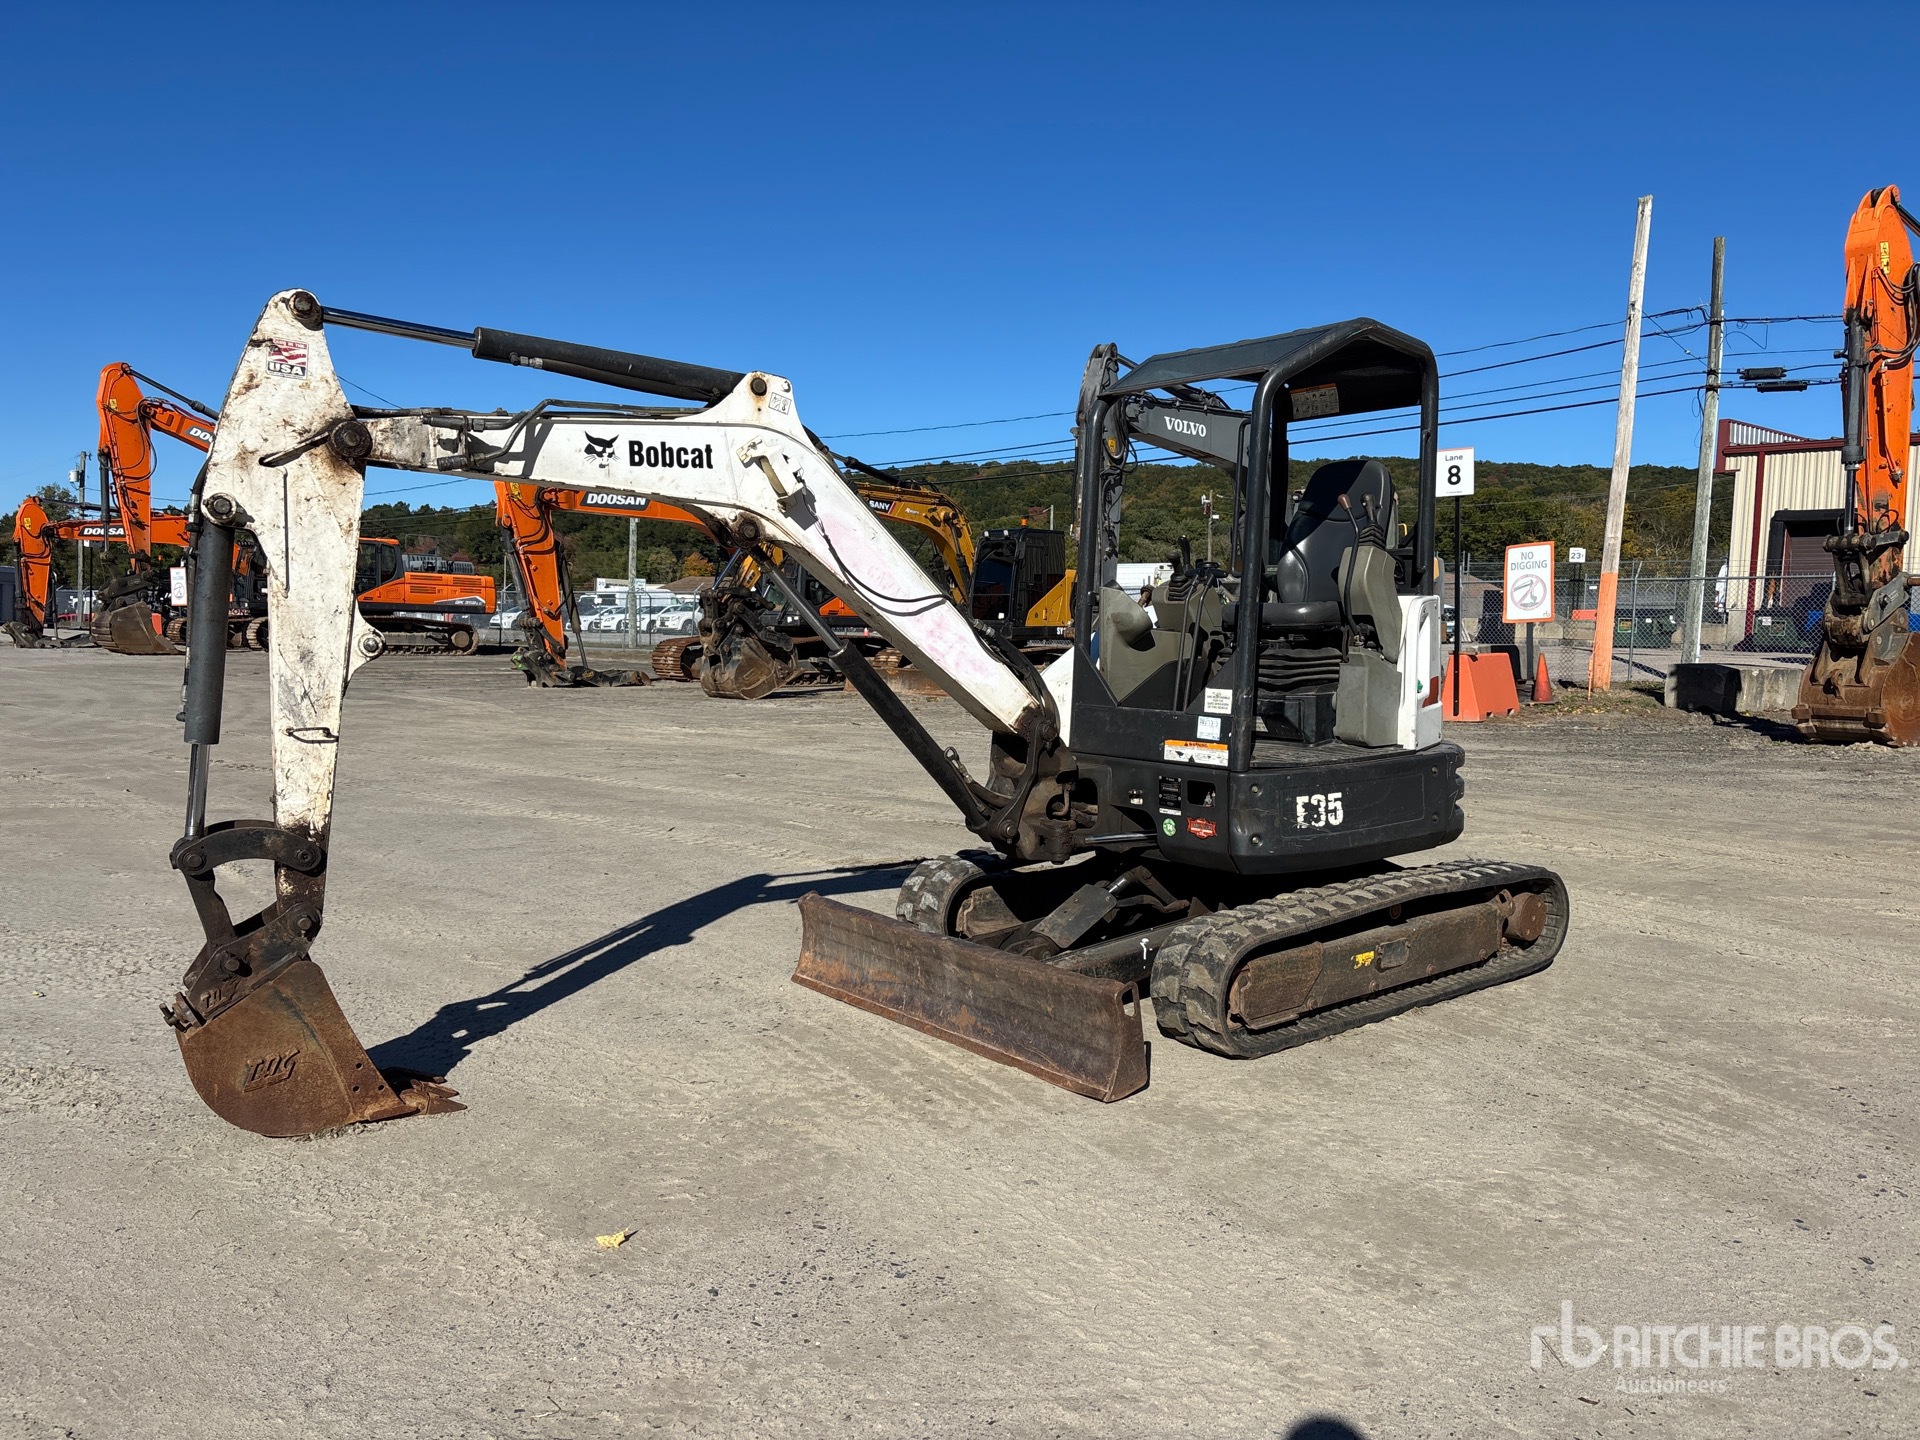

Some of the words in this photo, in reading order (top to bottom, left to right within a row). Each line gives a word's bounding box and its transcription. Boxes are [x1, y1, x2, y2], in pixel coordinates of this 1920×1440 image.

[269, 361, 304, 376] USA
[1163, 416, 1207, 438] VOLVO
[628, 440, 714, 469] Bobcat
[1447, 465, 1462, 485] 8
[586, 493, 647, 506] DOOSAN
[869, 500, 890, 511] SANY
[1520, 551, 1534, 560] NO
[1570, 552, 1582, 560] 23
[1510, 560, 1548, 571] DIGGING
[1056, 626, 1066, 635] SY
